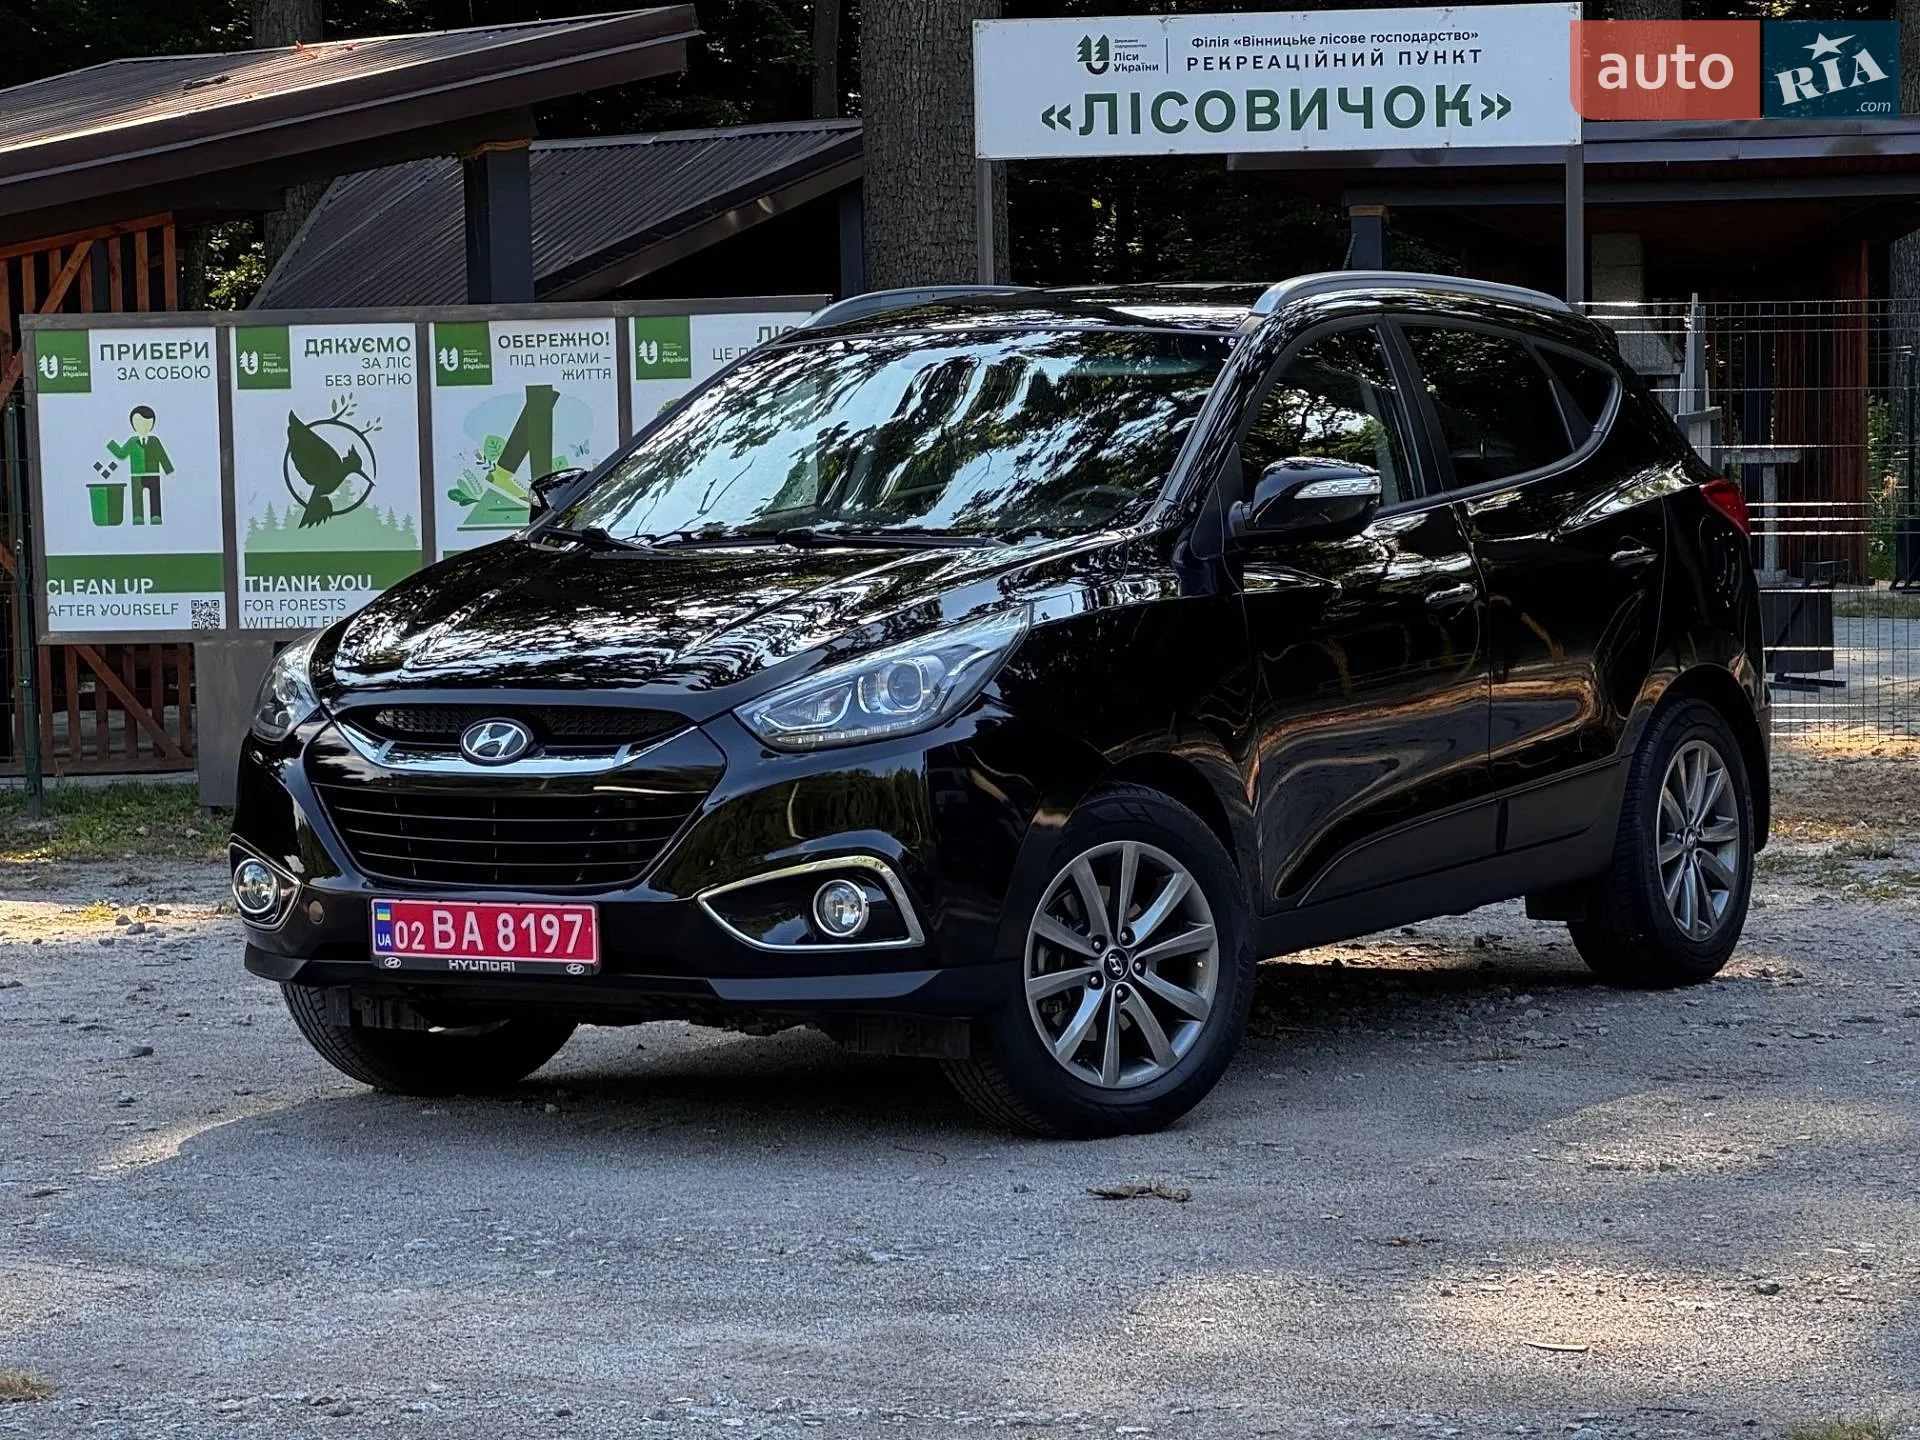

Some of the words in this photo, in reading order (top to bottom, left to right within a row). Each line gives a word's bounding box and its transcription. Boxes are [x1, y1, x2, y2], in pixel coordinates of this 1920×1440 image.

[1192, 35, 1229, 48] Філія
[1233, 33, 1316, 47] «Вінницьке
[1320, 32, 1366, 45] лісове
[1370, 30, 1479, 44] господарство»
[1114, 52, 1139, 61] Ліси
[1187, 48, 1384, 71] РЕКРЕАЦІЙНИЙ
[1399, 49, 1482, 66] ПУНКТ
[1113, 62, 1159, 73] України
[1041, 84, 1512, 136] «ЛІСОВИЧОК»
[304, 336, 411, 357] ДЯКУЄМО
[498, 331, 610, 349] ОБЕРЕЖНО!
[100, 341, 209, 361] ПРИБЕРИ
[712, 347, 734, 362] ЦЕ
[361, 357, 382, 369] ЗА
[385, 356, 411, 369] ЛІС
[509, 354, 535, 367] ПІД
[539, 353, 599, 365] НОГАМИ
[117, 367, 140, 380] ЗА
[145, 366, 211, 380] СОБОЮ
[325, 374, 352, 387] БЕЗ
[357, 373, 412, 386] ВОГНЮ
[562, 368, 611, 380] ЖИТТЯ
[46, 578, 116, 595] CLEAN
[124, 578, 154, 594] UP
[244, 575, 321, 592] THANK
[327, 574, 372, 591] YOU
[48, 604, 96, 617] AFTER
[100, 602, 179, 616] YOURSELF
[244, 599, 274, 612] FOR
[279, 598, 346, 611] FORESTS
[244, 616, 317, 629] WITHOUT
[395, 921, 426, 951] 02
[432, 910, 484, 951] BA
[496, 912, 583, 954] 8197
[377, 934, 392, 947] UA
[448, 959, 516, 972] HYUNDAI
